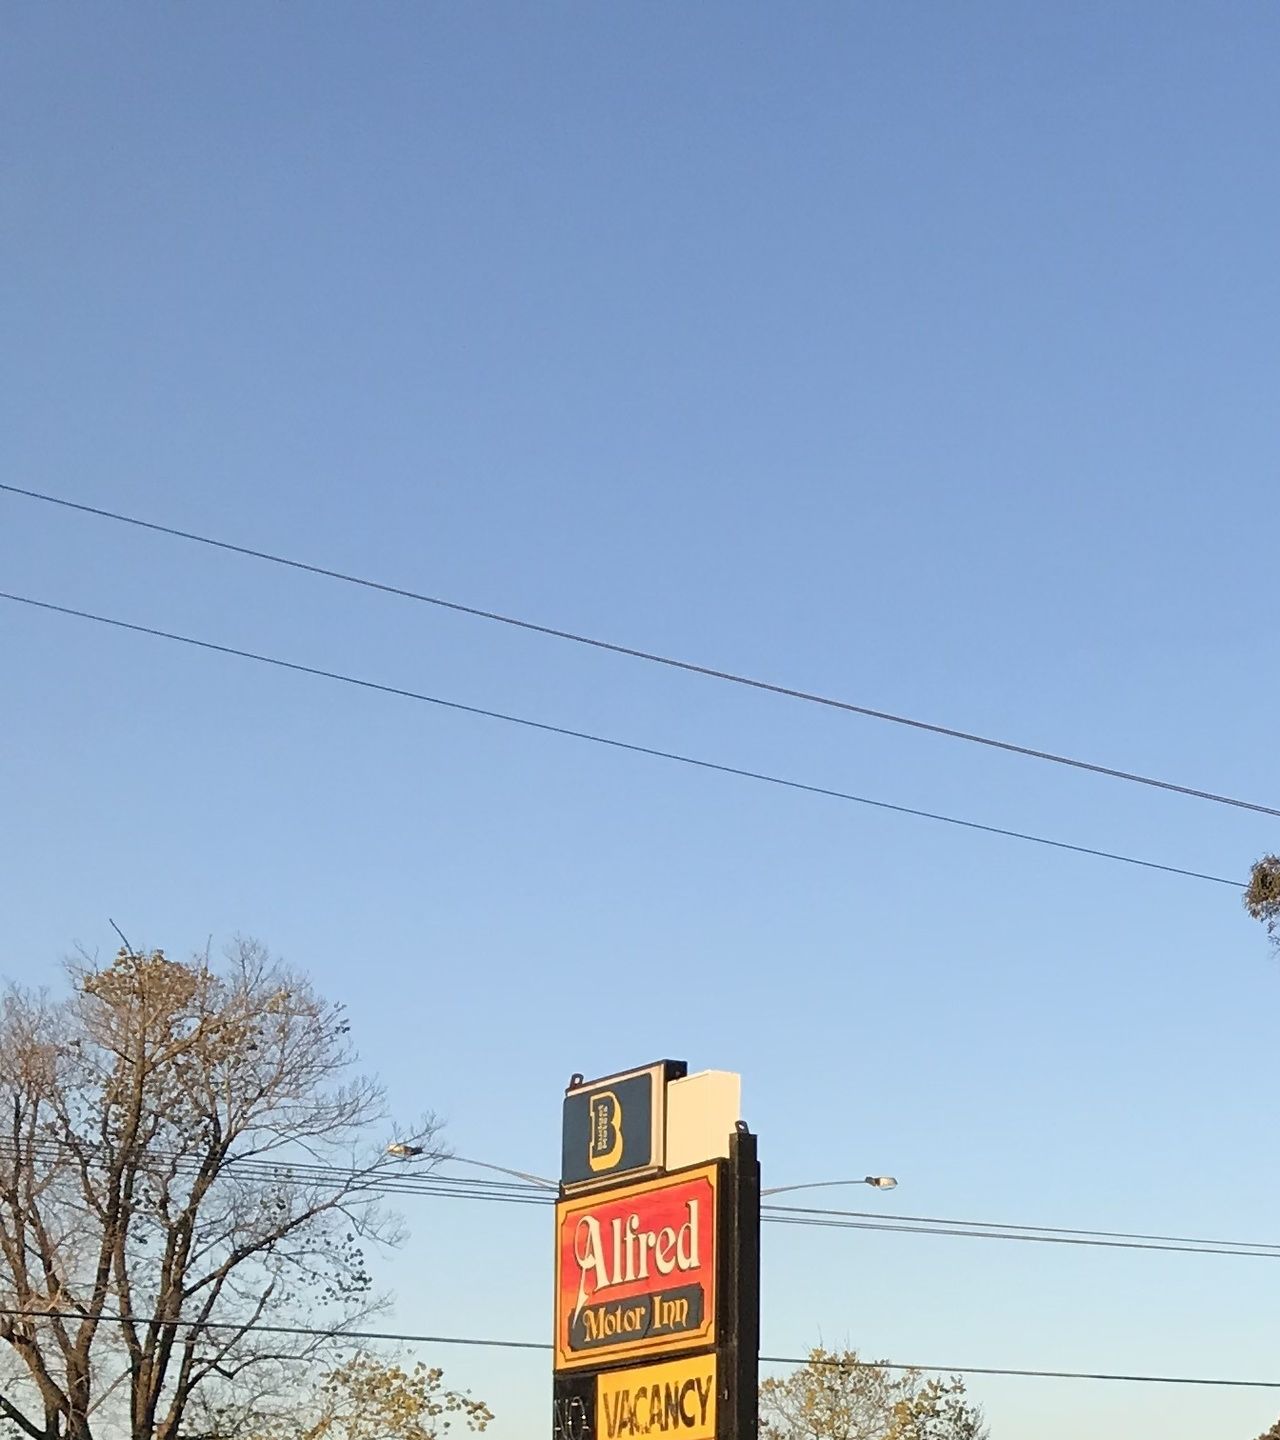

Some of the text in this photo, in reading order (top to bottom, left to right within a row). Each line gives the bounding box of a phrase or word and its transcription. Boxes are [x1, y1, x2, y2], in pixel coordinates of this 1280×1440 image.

[590, 1091, 622, 1172] B
[573, 1199, 701, 1328] Alfred
[583, 1296, 688, 1342] Motor Inn
[603, 1375, 713, 1439] VACANCY
